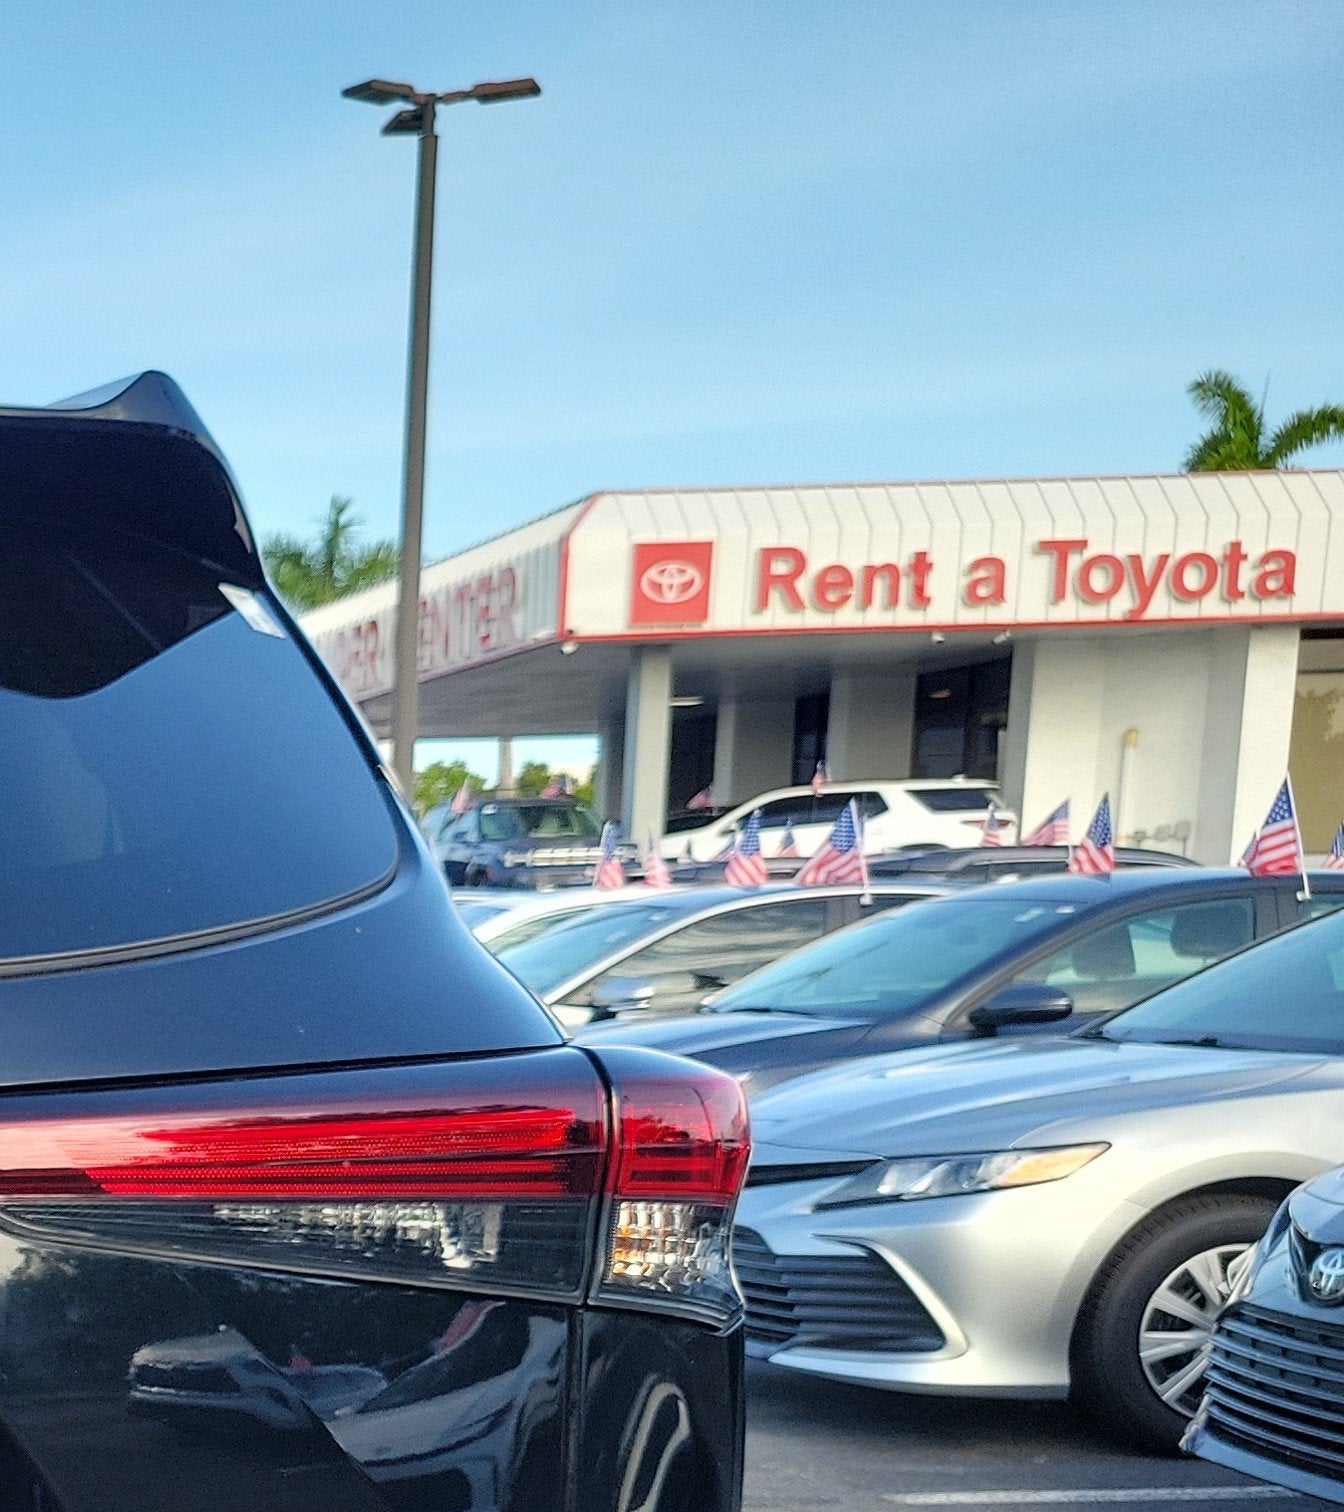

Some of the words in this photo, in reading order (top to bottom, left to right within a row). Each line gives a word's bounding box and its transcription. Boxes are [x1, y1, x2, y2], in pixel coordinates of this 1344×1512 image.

[753, 547, 933, 612] Rent
[963, 554, 1006, 607] a
[1037, 539, 1297, 621] Toyota
